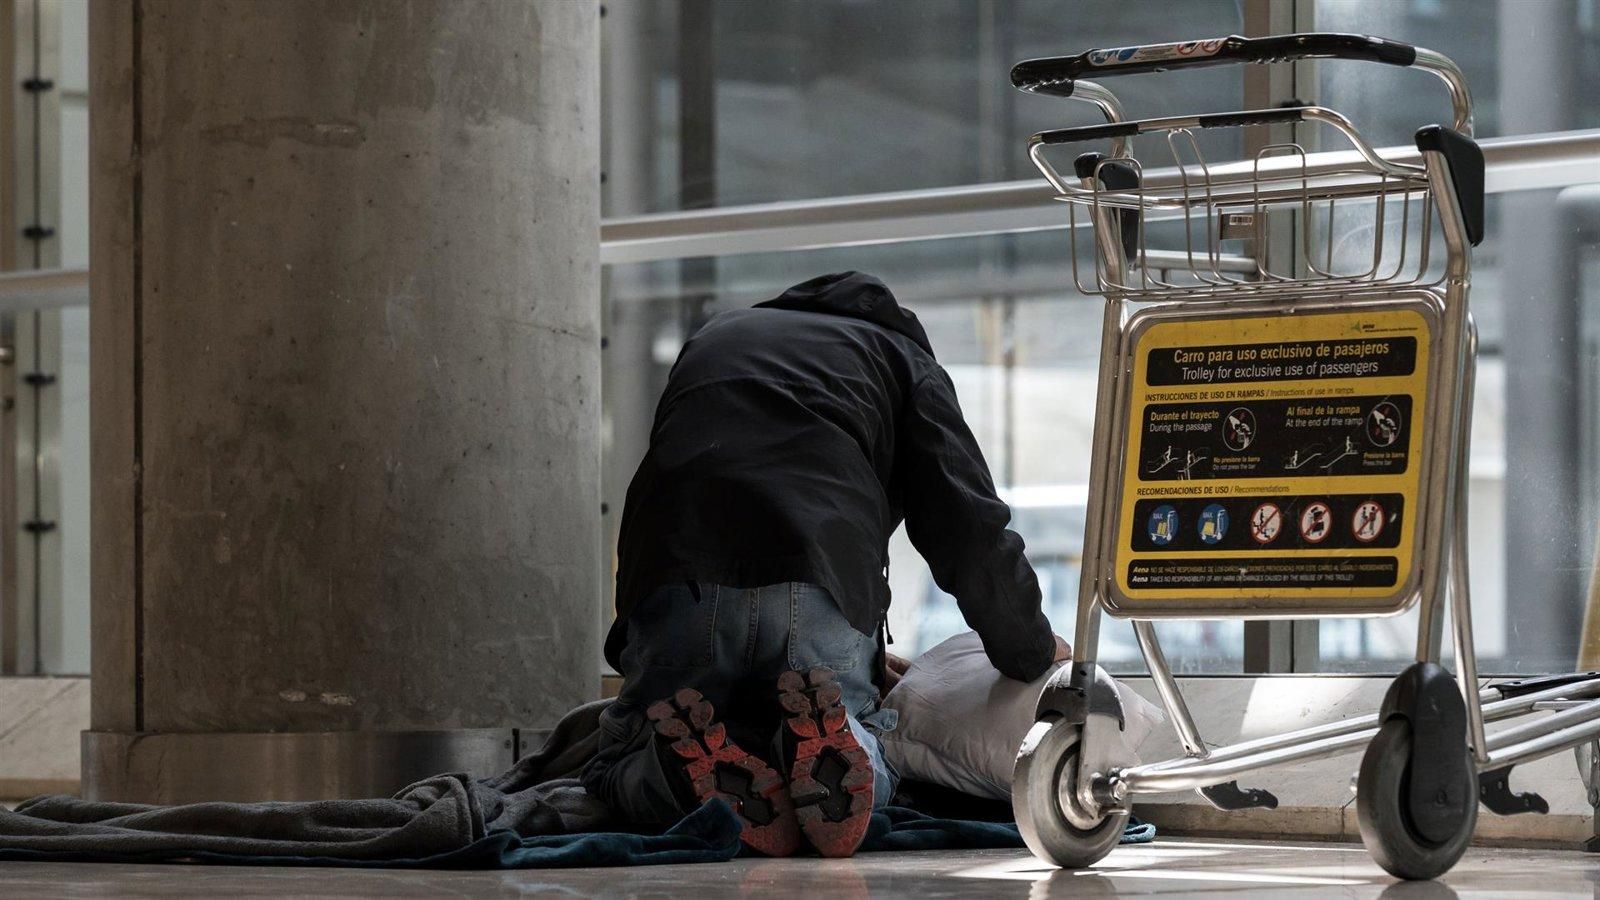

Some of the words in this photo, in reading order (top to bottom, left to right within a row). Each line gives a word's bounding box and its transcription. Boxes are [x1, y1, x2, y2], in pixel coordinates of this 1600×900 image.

[1174, 349, 1205, 363] Carro
[1208, 350, 1233, 365] para
[1237, 349, 1257, 361] uso
[1260, 344, 1313, 360] exclusivo
[1316, 343, 1330, 357] de
[1334, 341, 1390, 359] pasajeros
[1182, 366, 1214, 382] Trolley
[1218, 365, 1231, 379] for
[1234, 363, 1282, 378] exclusive
[1284, 365, 1304, 376] use
[1306, 361, 1318, 375] of
[1320, 361, 1379, 377] passengers
[1145, 392, 1198, 401] INSTRUCCIONES
[1200, 391, 1209, 400] DE
[1211, 391, 1225, 399] USO
[1226, 390, 1236, 398] EN
[1237, 389, 1265, 398] RAMPAS
[1271, 388, 1306, 397] Instructions
[1335, 387, 1354, 395] ramps
[1151, 411, 1180, 421] Durante
[1181, 410, 1189, 420] el
[1190, 410, 1220, 421] trayecto
[1286, 407, 1295, 416] Al
[1297, 406, 1313, 415] final
[1315, 406, 1325, 415] de
[1327, 405, 1334, 414] la
[1336, 406, 1360, 415] rampa
[1286, 418, 1294, 427] At
[1296, 418, 1307, 426] the
[1308, 418, 1321, 426] end
[1323, 418, 1330, 426] of
[1331, 417, 1343, 425] the
[1344, 418, 1363, 426] ramp
[1150, 423, 1172, 433] During
[1173, 423, 1185, 431] the
[1186, 423, 1213, 432] passage
[1221, 456, 1241, 464] presione
[1137, 487, 1202, 496] RECOMENDACIONES
[1215, 486, 1229, 494] USO
[1234, 485, 1290, 494] Recommendations
